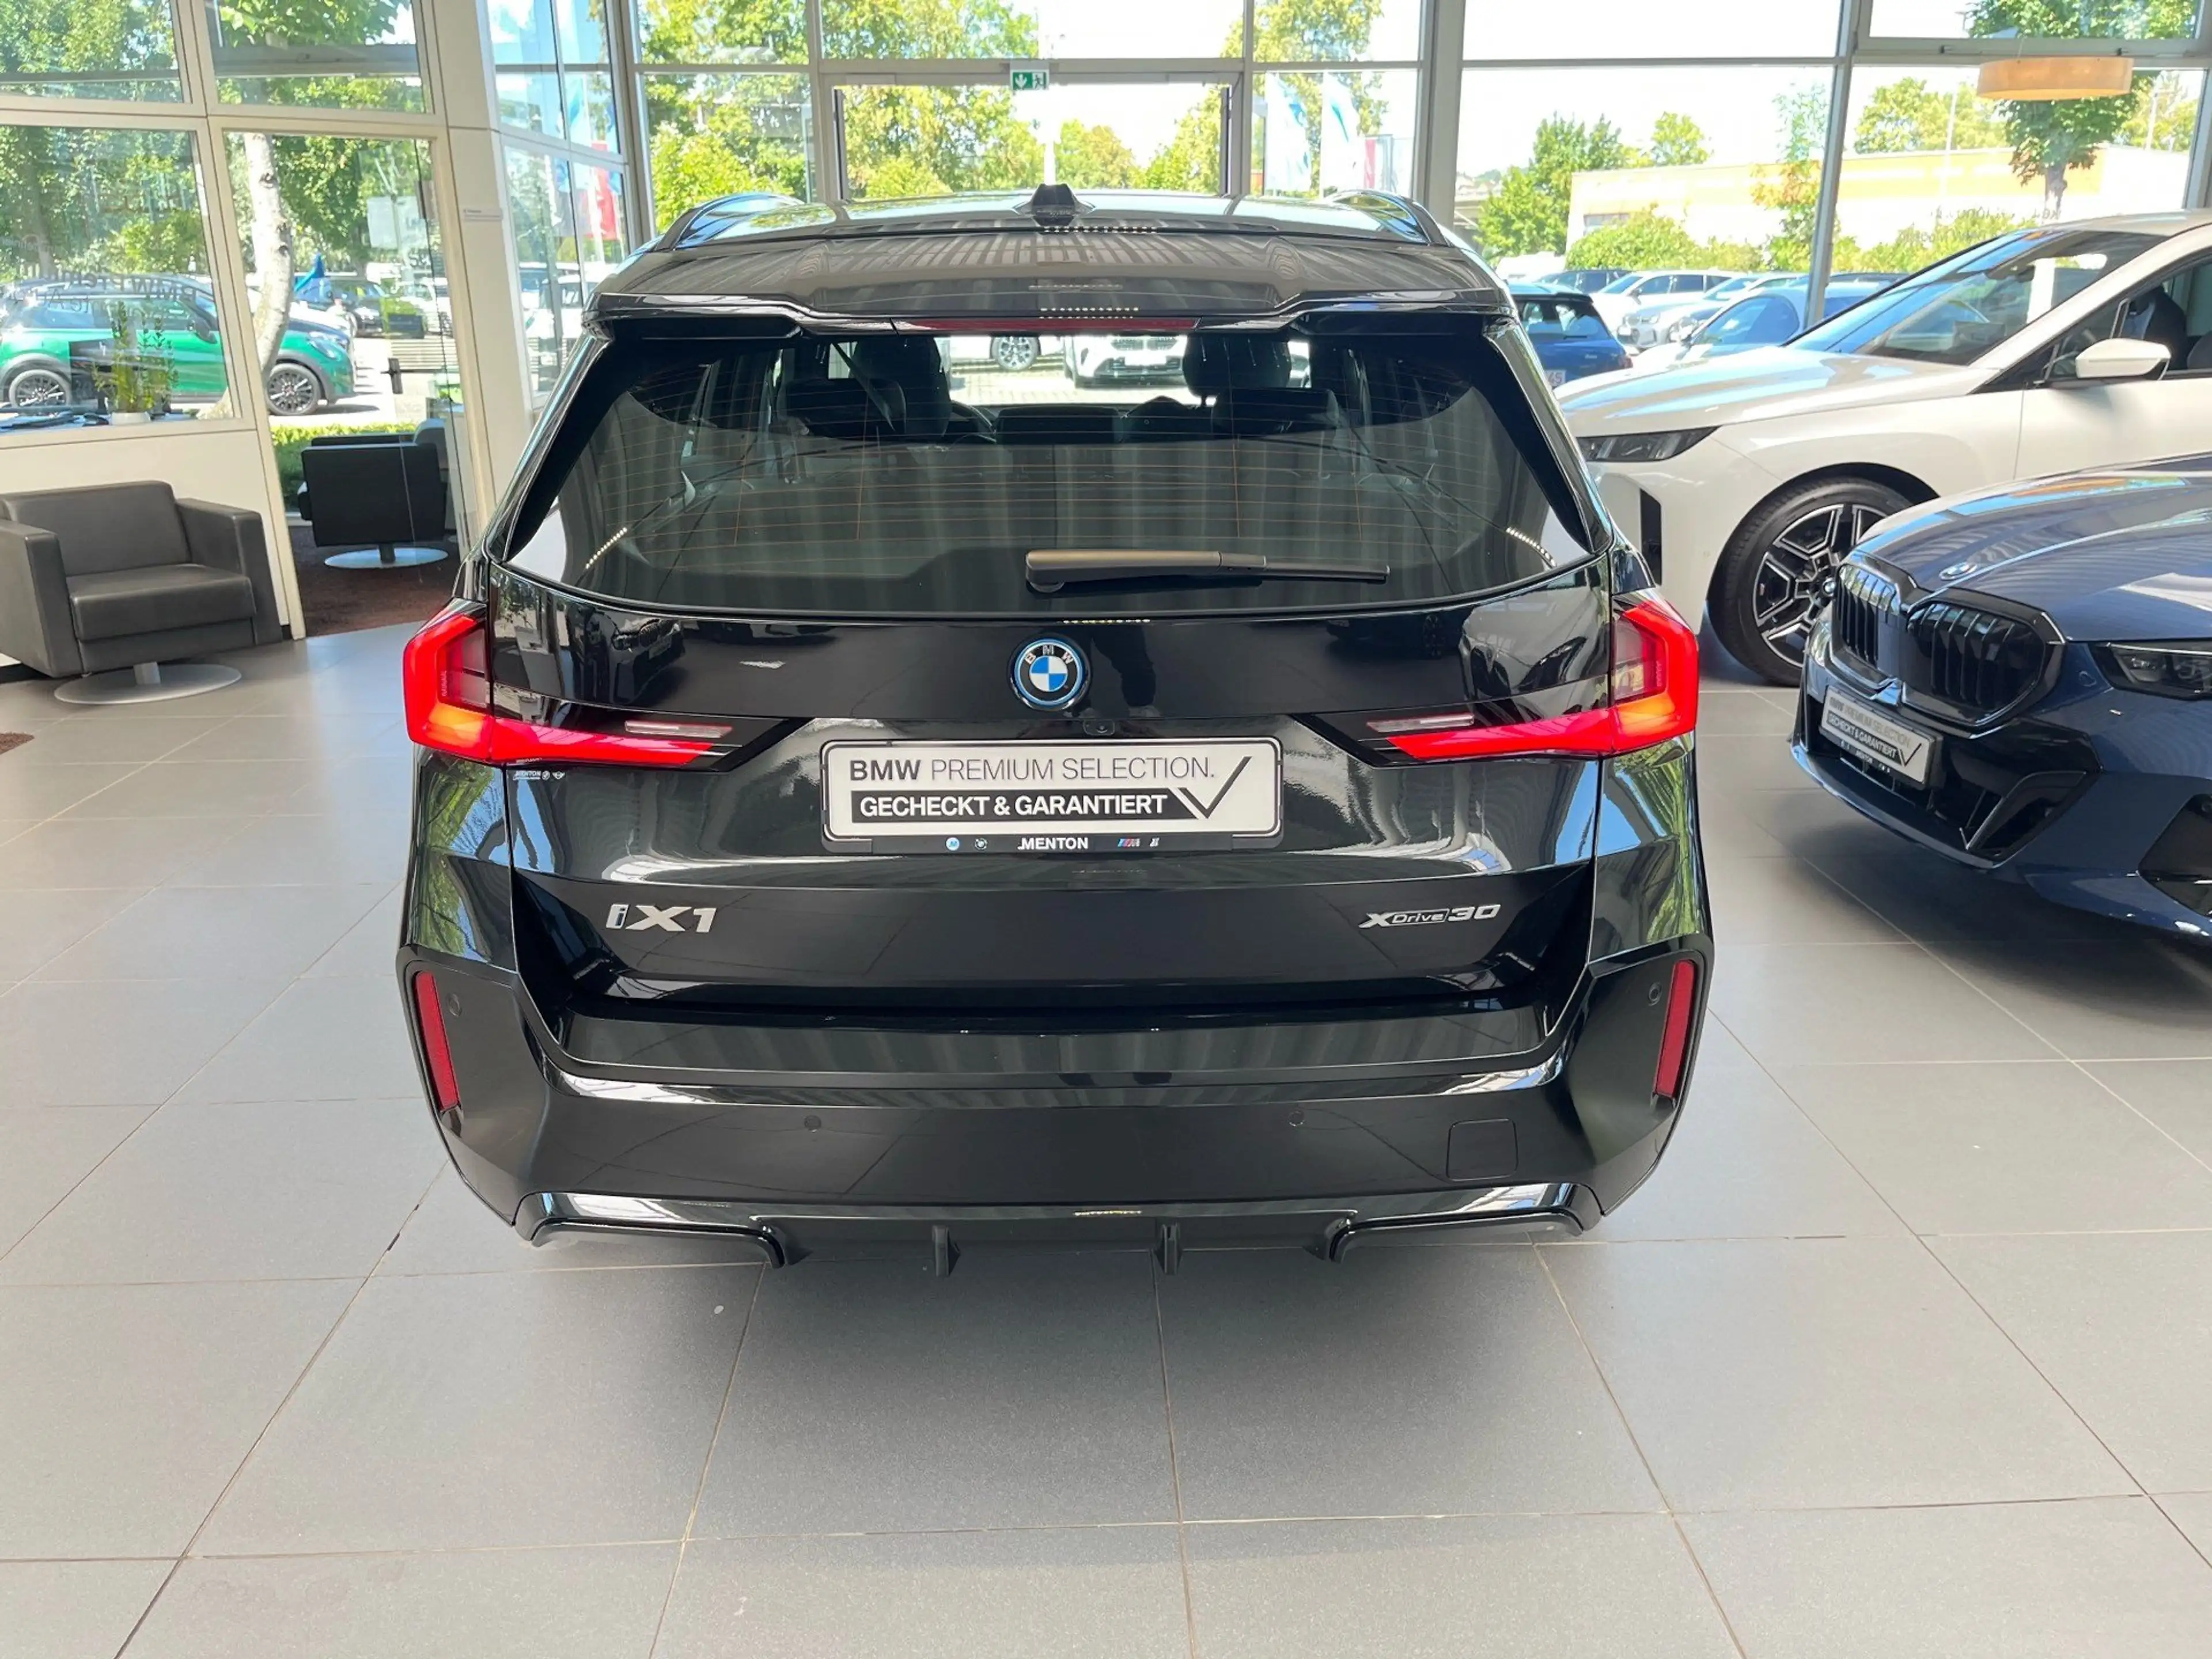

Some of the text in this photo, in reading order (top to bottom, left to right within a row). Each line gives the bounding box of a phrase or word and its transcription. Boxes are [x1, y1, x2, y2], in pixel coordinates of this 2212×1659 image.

[1024, 645, 1074, 665] BMW
[850, 757, 1214, 781] BMW PREMIUM SELECTION.
[861, 794, 1168, 816] GECHECKT & GARANTIERT
[1017, 837, 1088, 850] MENTON
[606, 903, 717, 933] iX1
